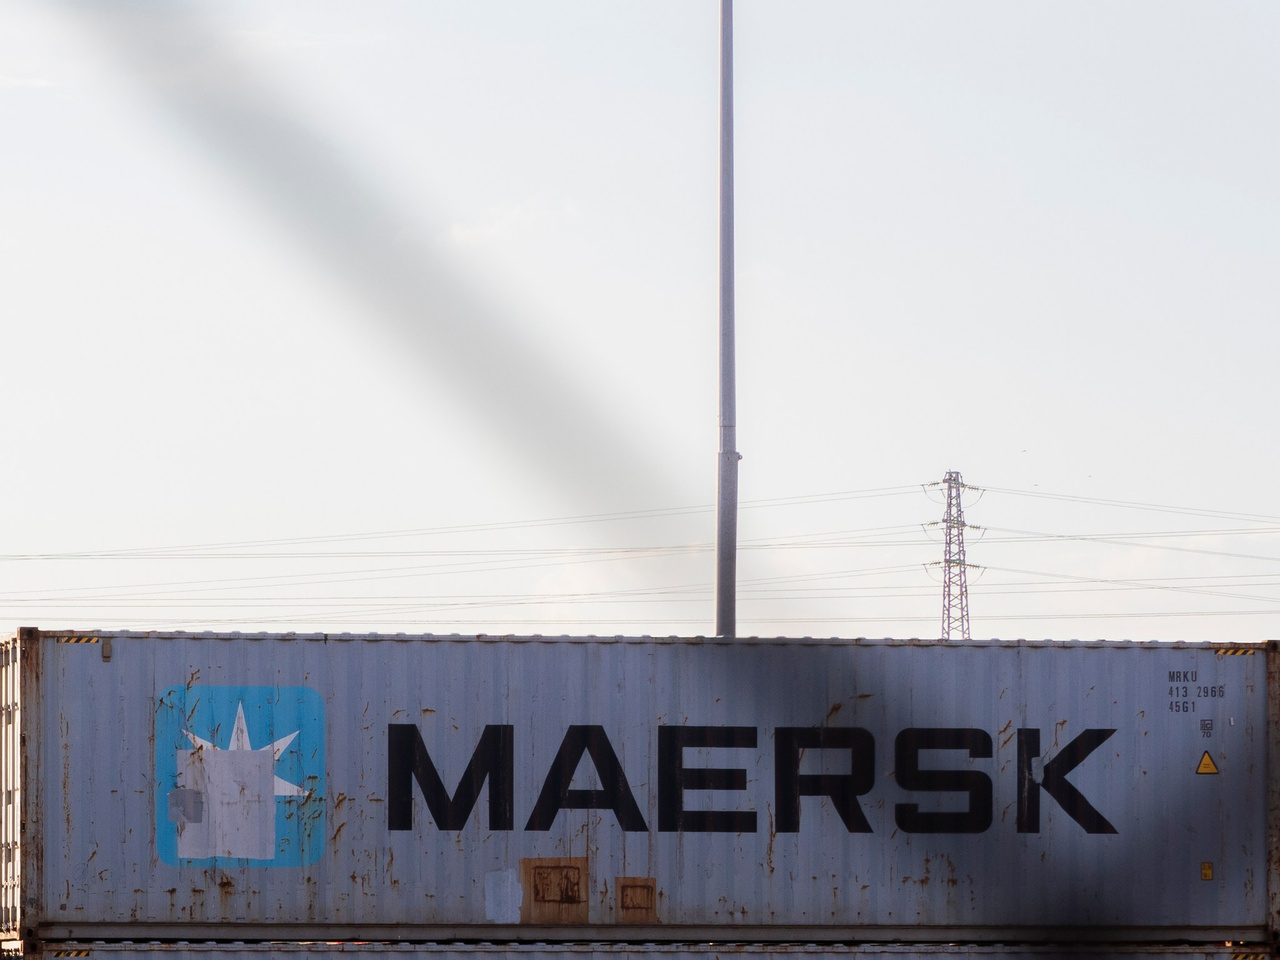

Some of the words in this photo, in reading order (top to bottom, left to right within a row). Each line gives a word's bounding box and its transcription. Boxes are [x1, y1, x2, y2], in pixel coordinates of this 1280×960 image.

[1168, 671, 1197, 682] MRKU
[1168, 686, 1188, 697] 413
[1197, 686, 1225, 697] 2966
[1168, 701, 1195, 712] 45G1
[387, 723, 1118, 834] MAERSK
